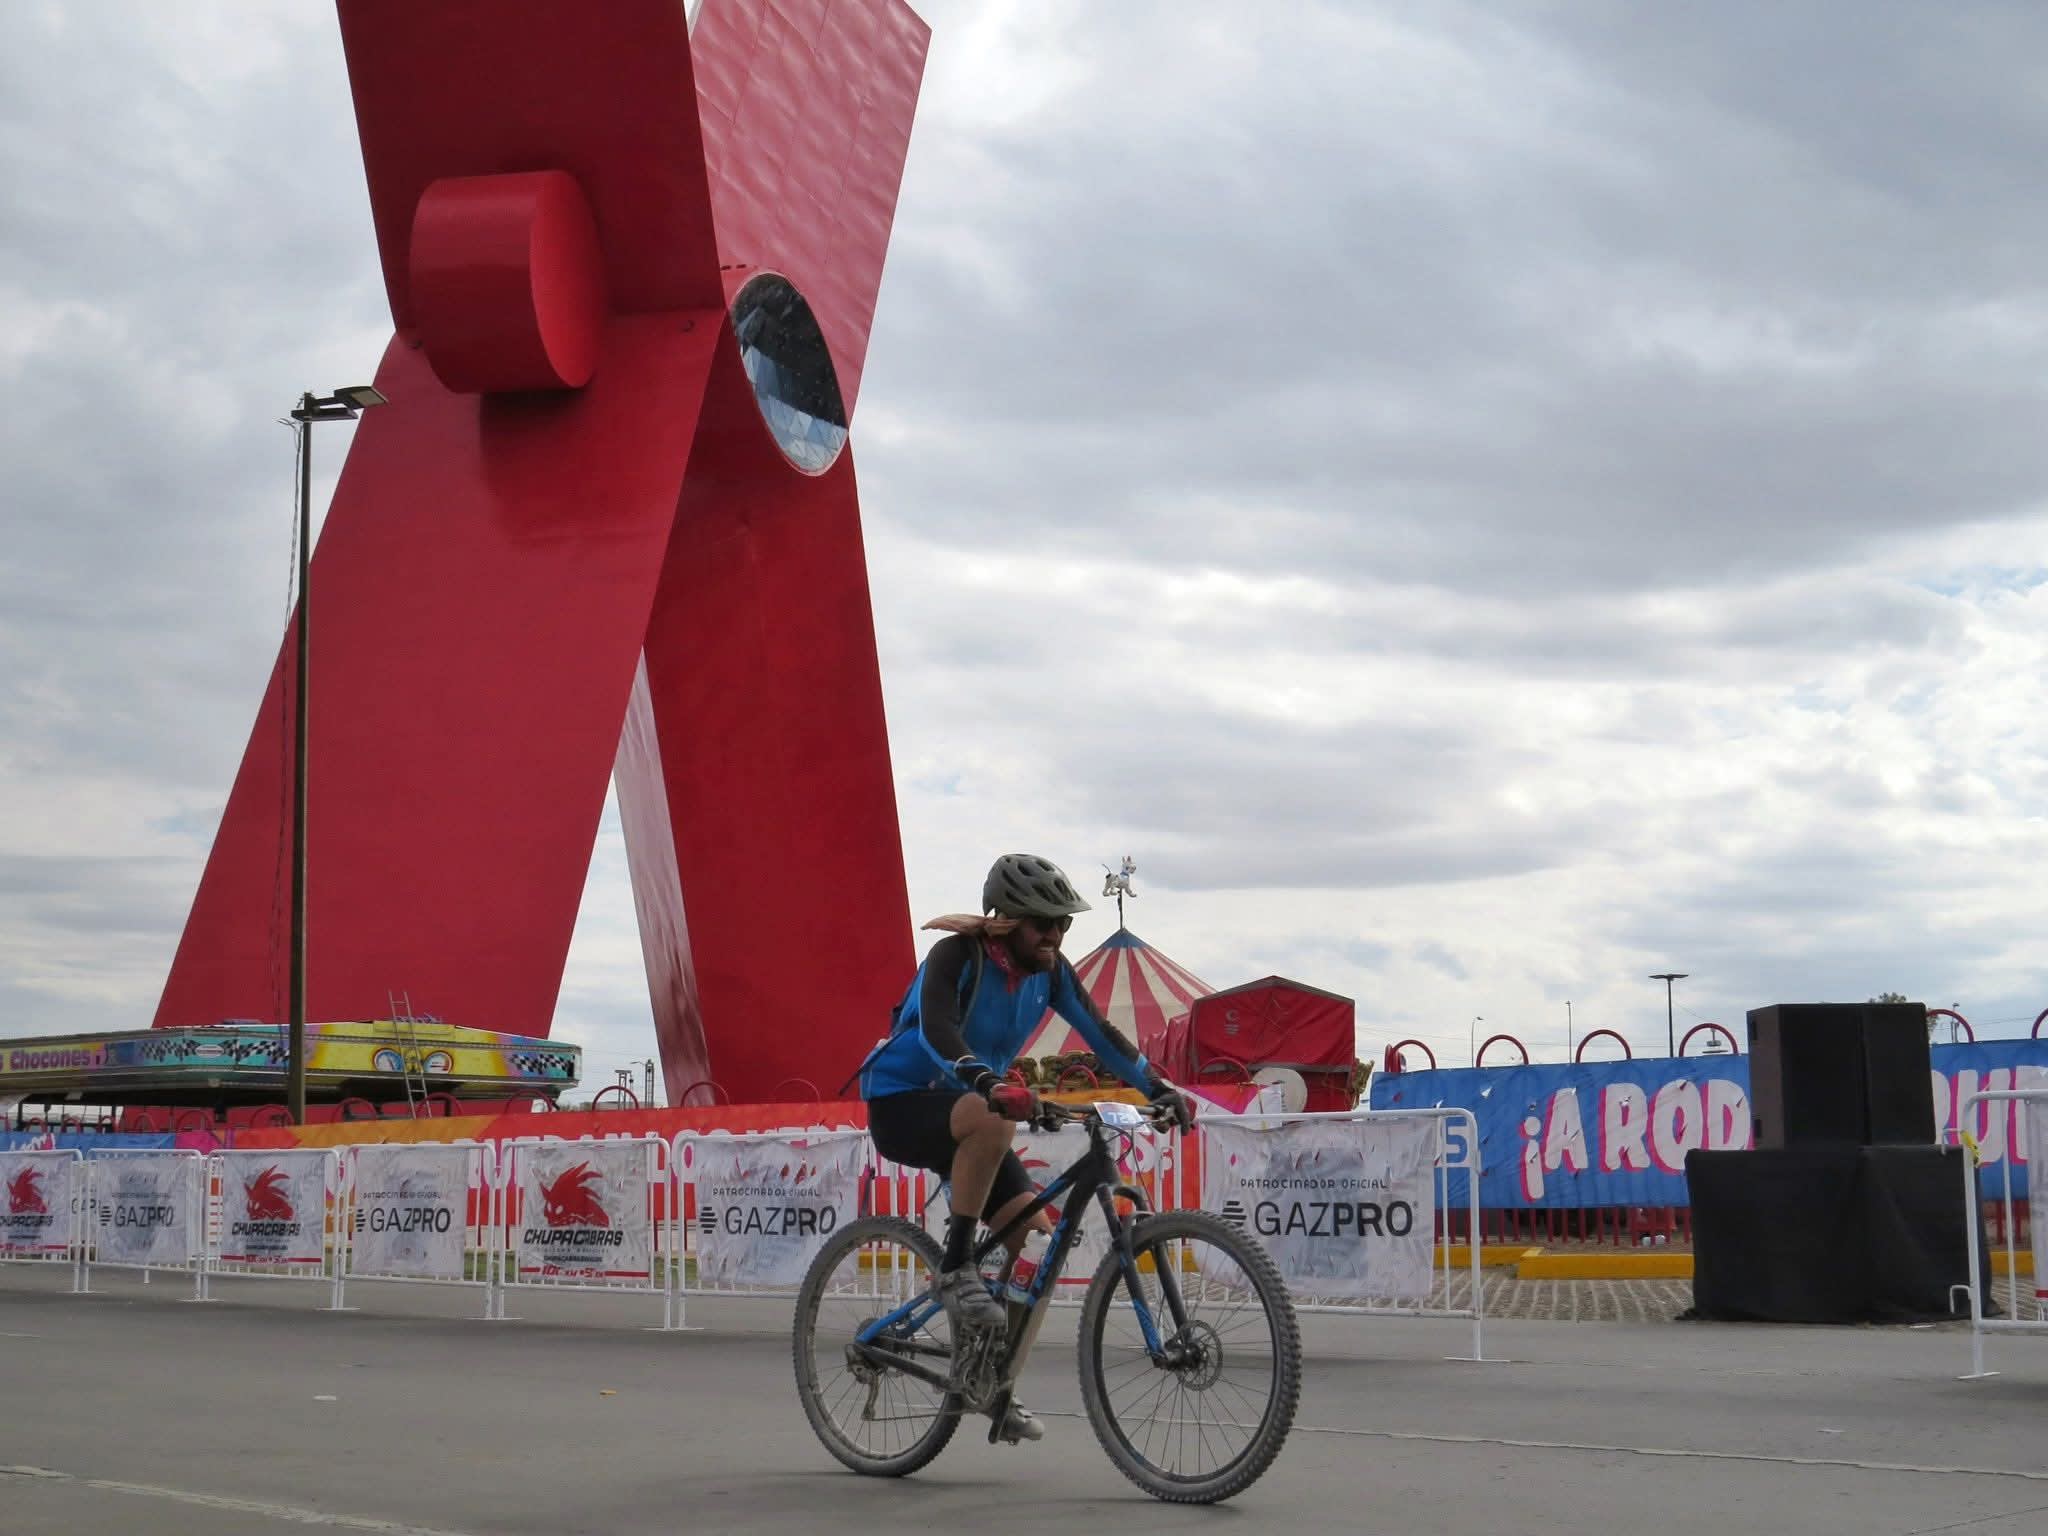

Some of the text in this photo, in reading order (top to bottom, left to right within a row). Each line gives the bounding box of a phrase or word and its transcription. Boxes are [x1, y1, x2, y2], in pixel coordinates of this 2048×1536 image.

[10, 1049, 91, 1071] Chocones
[1598, 1078, 1755, 1174] ROD
[1240, 1178, 1389, 1190] PATROCINADOR OFICIAL
[114, 1204, 175, 1228] GAZPRO
[369, 1207, 451, 1233] GAZPRO
[724, 1204, 837, 1237] GAZPRO
[1253, 1200, 1414, 1237] GAZPRO
[523, 1228, 624, 1247] CHUPACABRAS
